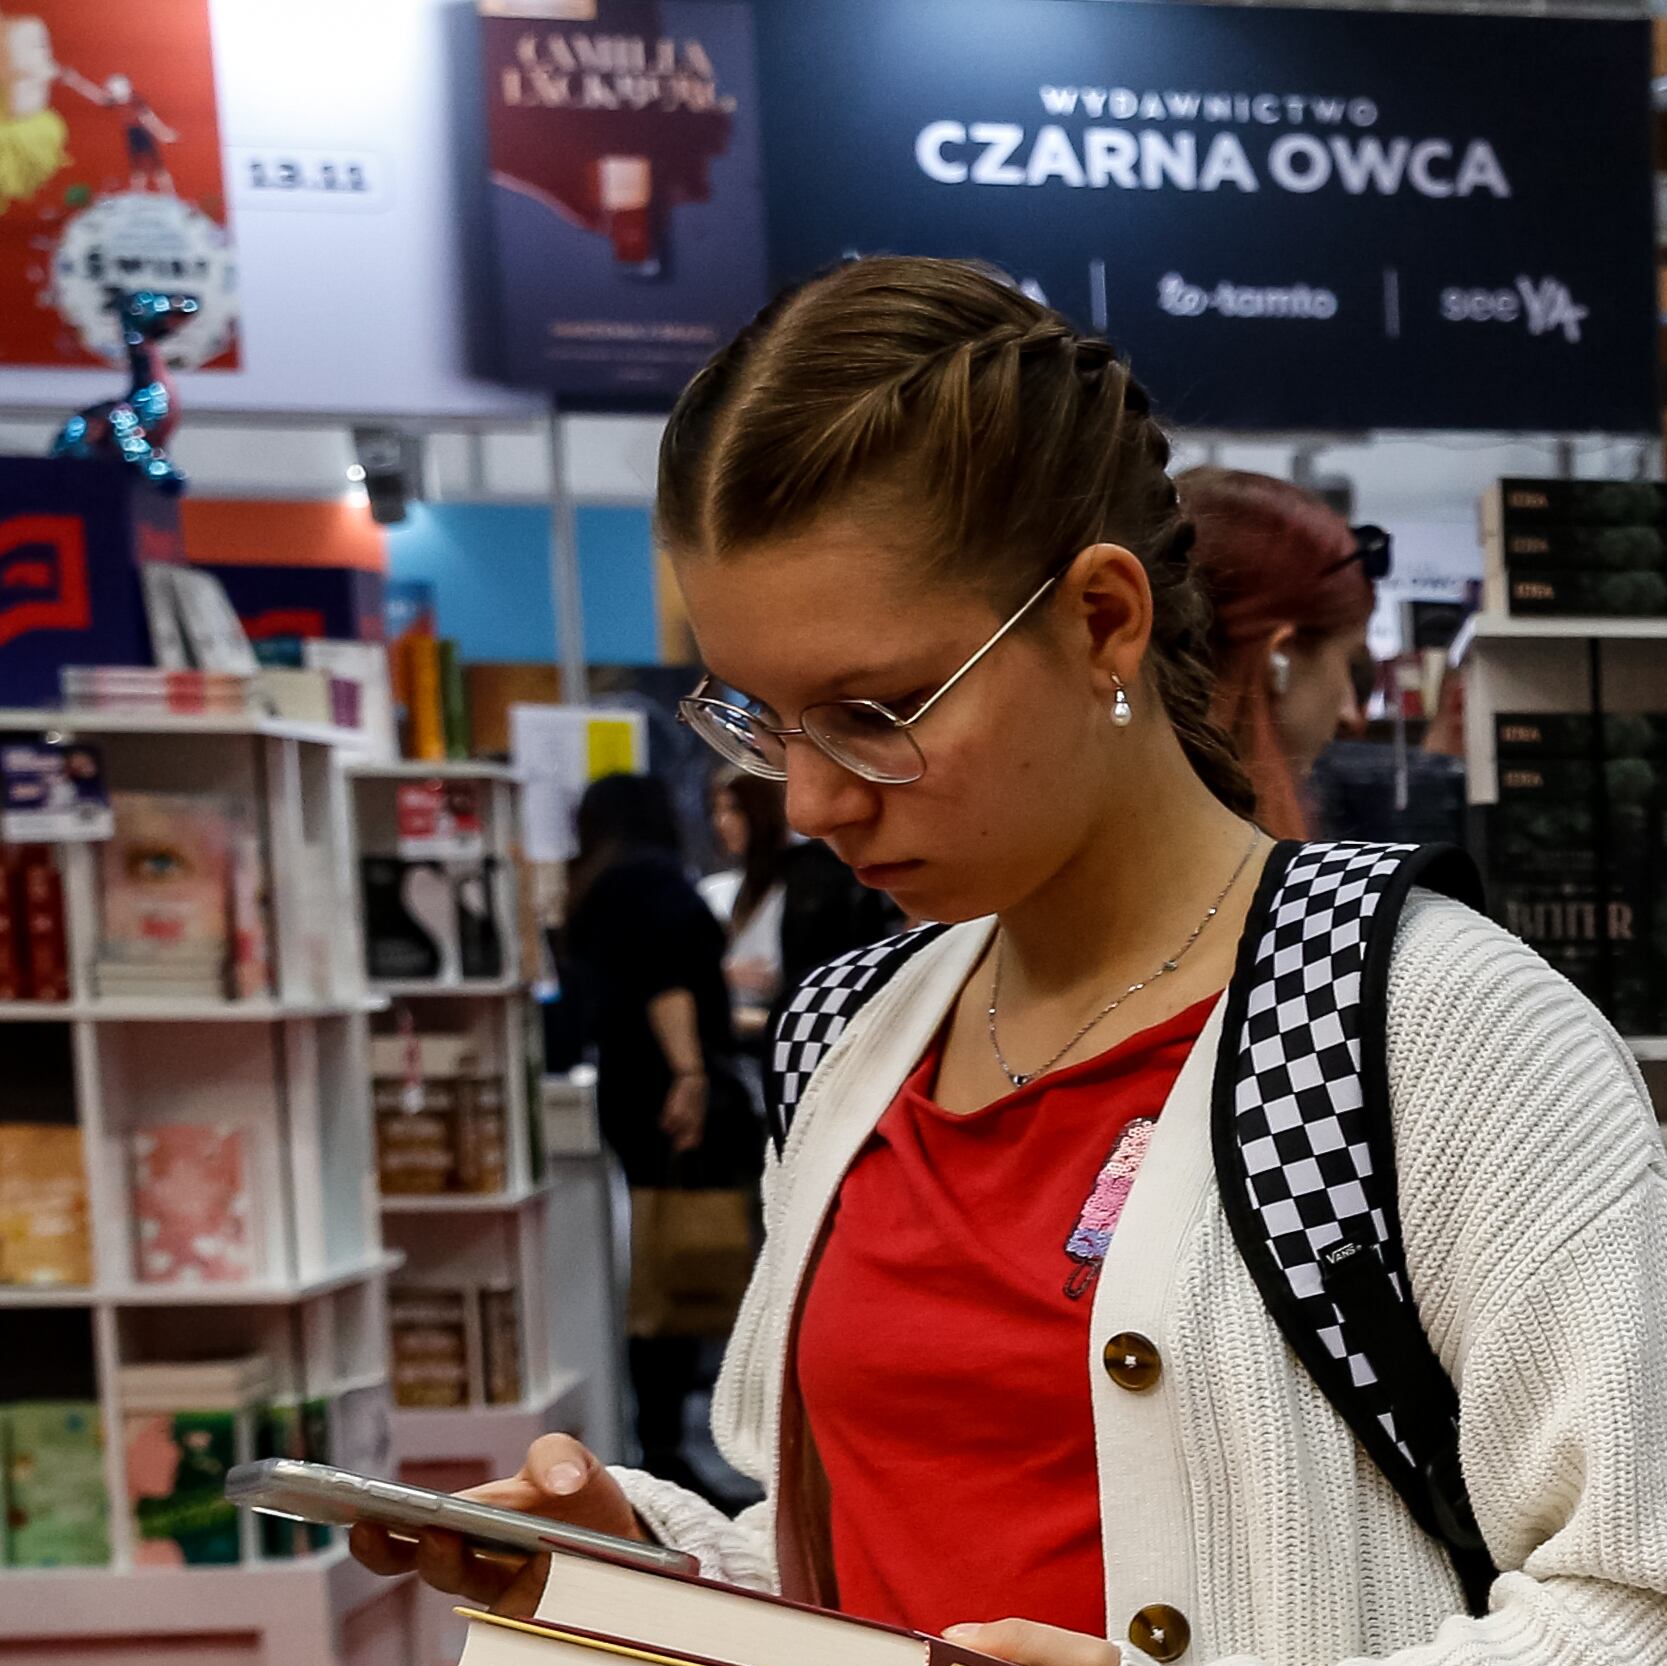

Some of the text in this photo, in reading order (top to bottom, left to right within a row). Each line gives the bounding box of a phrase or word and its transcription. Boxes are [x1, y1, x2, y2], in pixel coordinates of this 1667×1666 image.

[1037, 84, 1380, 128] WYDAWNICTWO
[914, 119, 1512, 200] CZARNA OWCA
